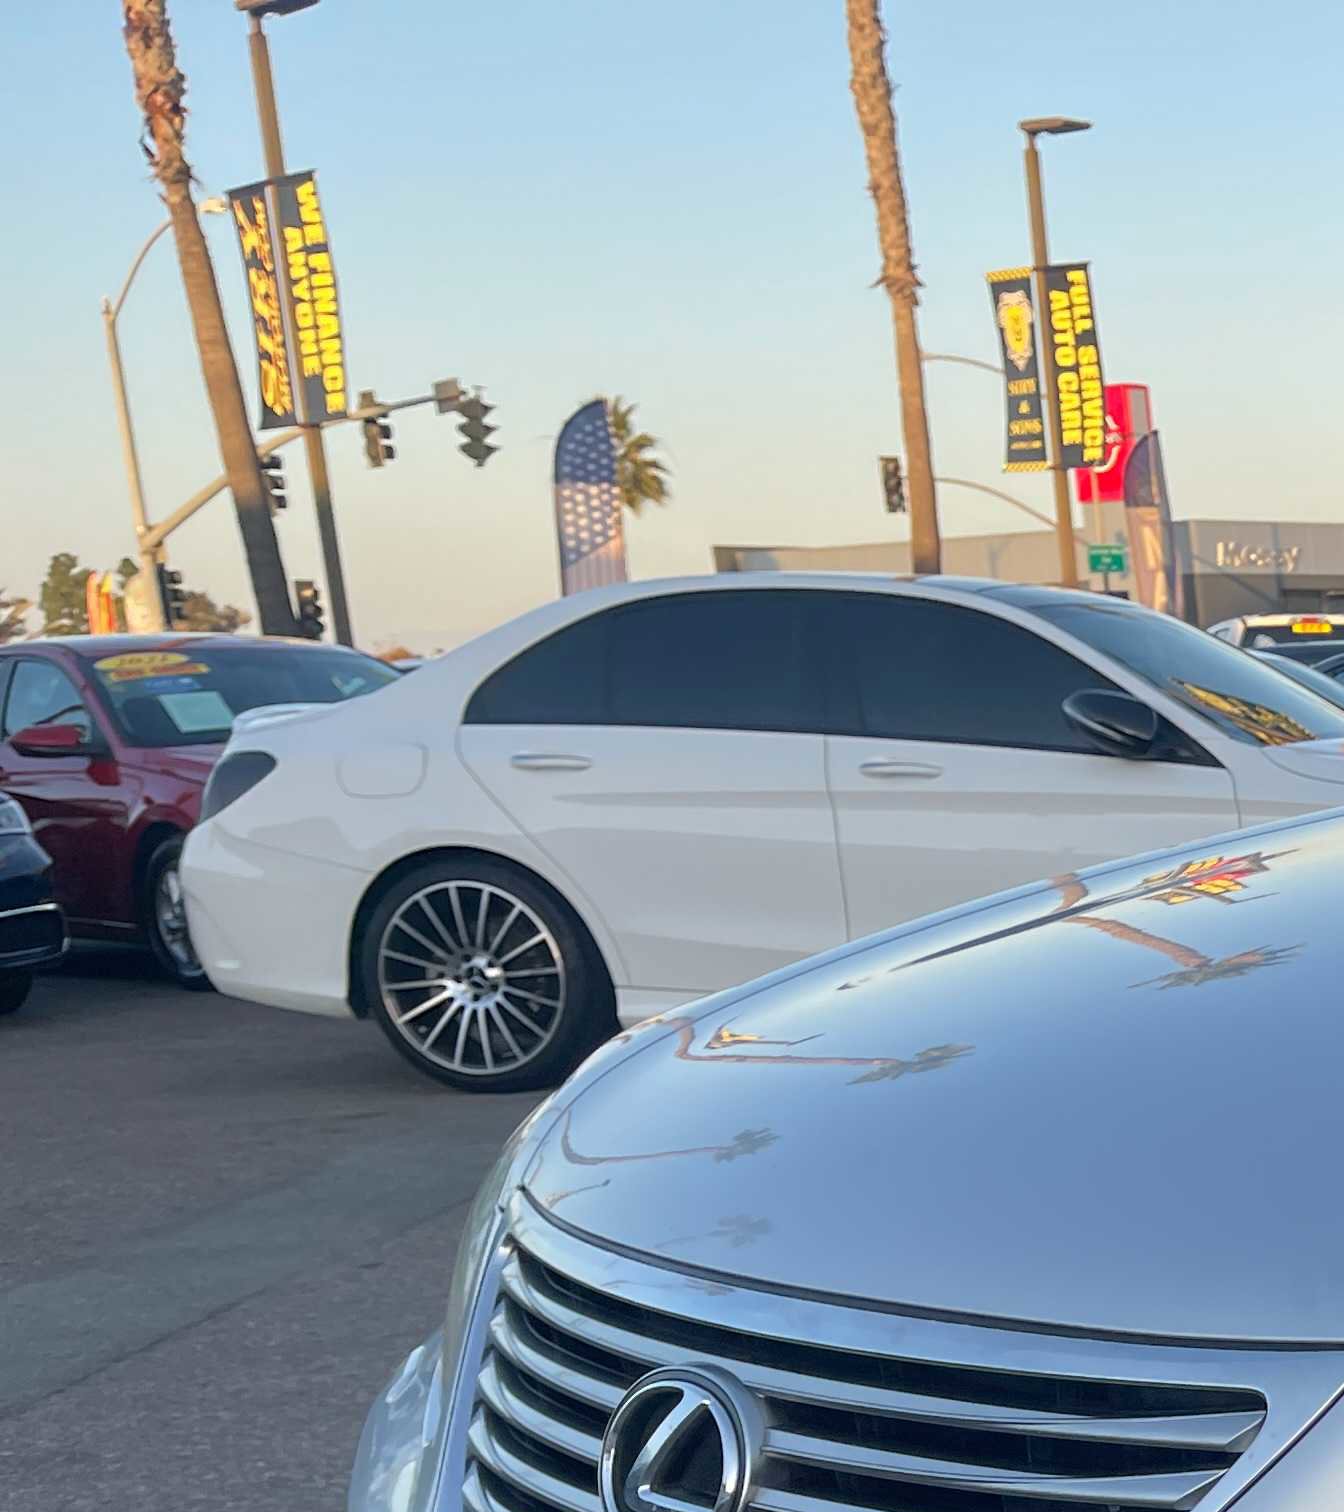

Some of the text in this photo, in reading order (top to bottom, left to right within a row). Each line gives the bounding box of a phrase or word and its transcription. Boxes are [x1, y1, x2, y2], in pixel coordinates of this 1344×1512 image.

[283, 227, 322, 378] ANYONE
[296, 181, 346, 415] WE FINANCE
[1049, 290, 1083, 446] AUTO CARE
[1066, 270, 1104, 463] FULL SERVICE
